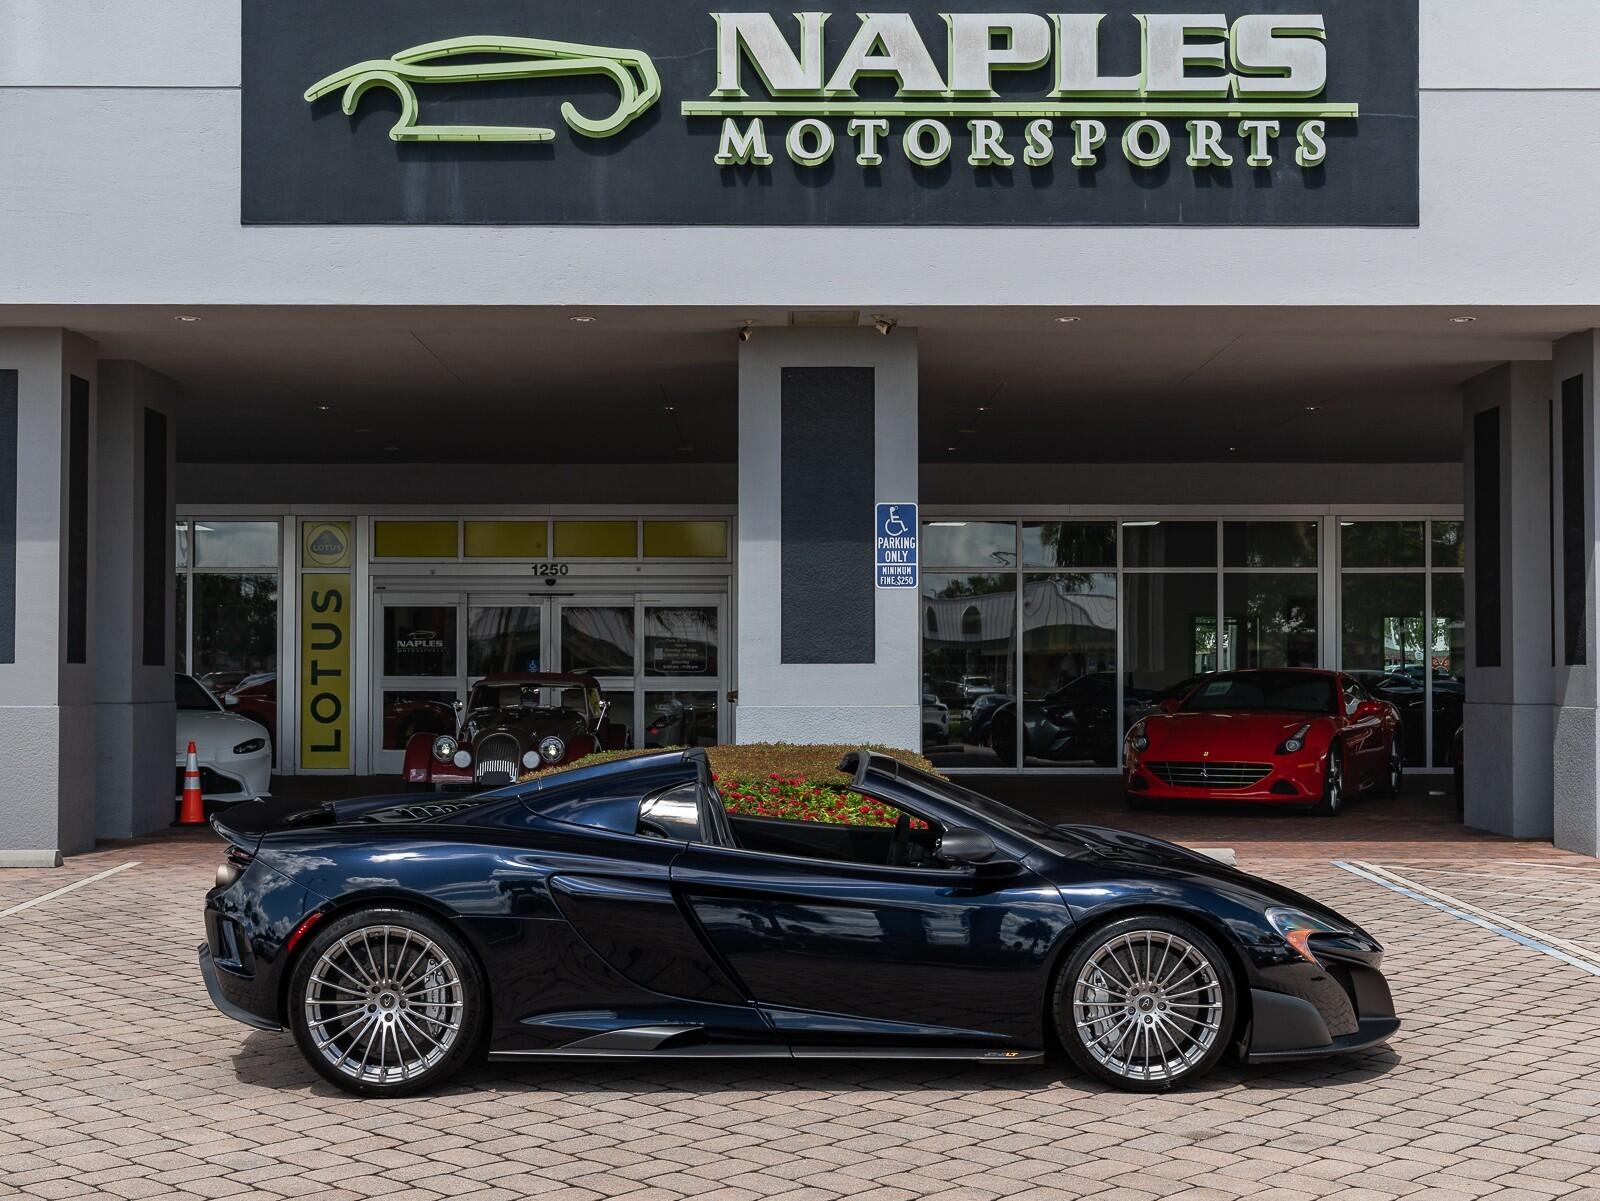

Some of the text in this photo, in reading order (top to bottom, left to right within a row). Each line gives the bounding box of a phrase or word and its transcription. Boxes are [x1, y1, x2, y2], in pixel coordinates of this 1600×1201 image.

[709, 12, 1327, 99] NAPLES
[713, 119, 1328, 167] MOTORSPORTS
[312, 544, 342, 552] LOTUS
[878, 537, 916, 549] PARKING
[885, 551, 908, 562] ONLY
[531, 563, 569, 576] 1250
[882, 566, 912, 575] MINIMUM
[880, 576, 913, 585] FINE $250
[396, 640, 443, 648] NAPLES
[310, 588, 342, 752] LOTUS
